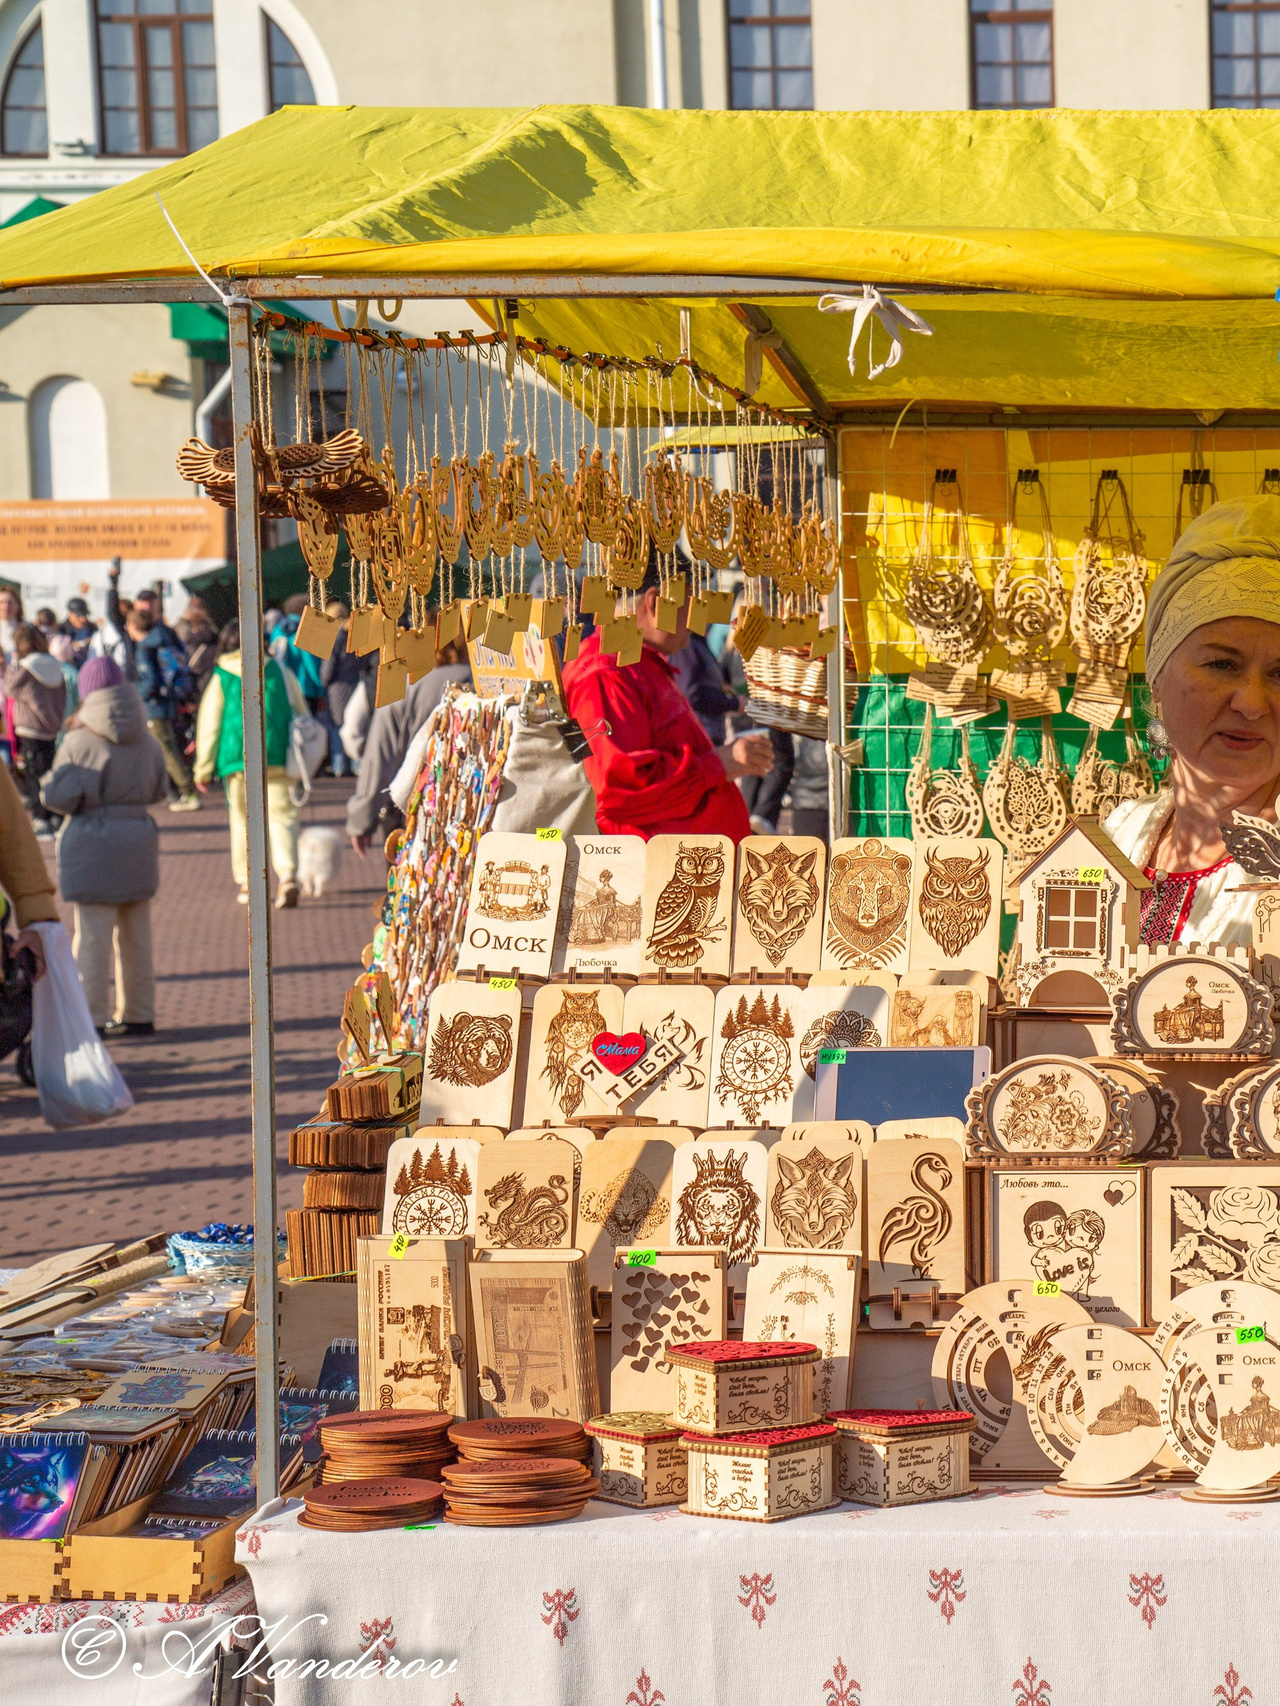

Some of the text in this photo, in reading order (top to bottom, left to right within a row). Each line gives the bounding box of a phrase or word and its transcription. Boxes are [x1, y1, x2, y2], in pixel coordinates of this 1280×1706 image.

[539, 829, 558, 840] 450
[583, 844, 622, 855] Омск
[1082, 868, 1102, 879] 650
[469, 928, 548, 953] Омск
[574, 958, 618, 968] Любочка
[491, 980, 513, 989] 450
[596, 1042, 640, 1056] Мама
[580, 1060, 604, 1082] Я
[605, 1044, 674, 1100] ТЕБЯ
[1000, 1178, 1069, 1190] Любовь это...
[394, 1234, 405, 1253] 450
[630, 1252, 652, 1265] 400
[1042, 1256, 1090, 1282] Love is
[430, 1276, 440, 1288] 5000
[1036, 1282, 1058, 1295] 650
[1094, 1306, 1120, 1314] целого
[958, 1314, 967, 1323] 2
[1172, 1313, 1182, 1323] 16
[494, 1314, 507, 1346] 2000
[1162, 1322, 1173, 1333] 15
[1155, 1334, 1166, 1345] 14
[1240, 1328, 1264, 1341] 550
[987, 1336, 1001, 1348] СБ
[494, 1352, 504, 1370] ДВЕ
[1044, 1352, 1054, 1362] 13
[1242, 1355, 1276, 1366] Омск
[973, 1358, 983, 1374] ПТ
[1036, 1363, 1046, 1374] 12
[1056, 1365, 1067, 1378] ОКТ
[1112, 1359, 1152, 1372] Омск
[1030, 1378, 1039, 1389] 11
[1069, 1381, 1079, 1391] Вт
[1183, 1380, 1193, 1393] ФЕВ
[728, 1388, 770, 1398] была светла!
[1028, 1393, 1035, 1403] 10
[1047, 1387, 1055, 1401] СЕН
[1198, 1401, 1205, 1413] Сб
[1048, 1412, 1057, 1424] АВГ
[1059, 1432, 1074, 1447] ИЮЛ
[1186, 1428, 1198, 1441] ДЕК
[898, 1445, 933, 1454] Чтоб жизнь,
[979, 1442, 991, 1453] 27
[1171, 1441, 1182, 1453] 31
[731, 1460, 752, 1468] Желаю
[898, 1458, 934, 1469] была светла!
[1181, 1454, 1192, 1464] 30
[736, 1474, 752, 1483] добра
